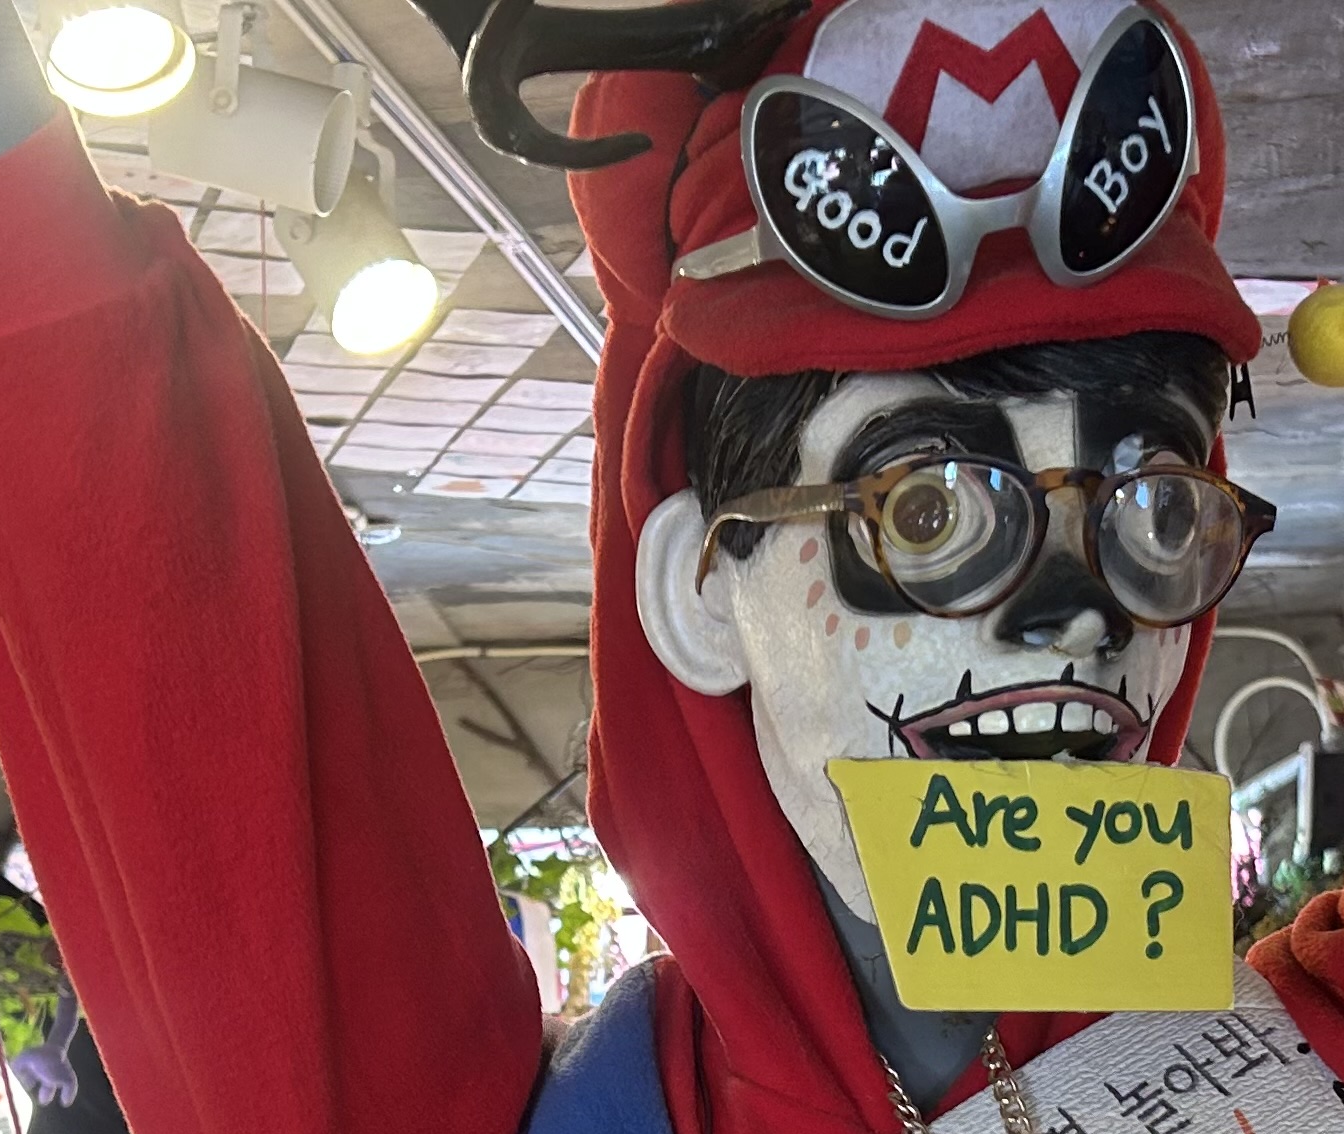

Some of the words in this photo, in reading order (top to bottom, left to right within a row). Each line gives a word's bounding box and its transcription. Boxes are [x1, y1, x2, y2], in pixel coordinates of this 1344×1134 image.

[882, 8, 1081, 156] M
[1084, 96, 1172, 214] Boy
[910, 774, 1042, 852] Are
[1066, 799, 1194, 866] you
[906, 876, 1109, 957] ADHD
